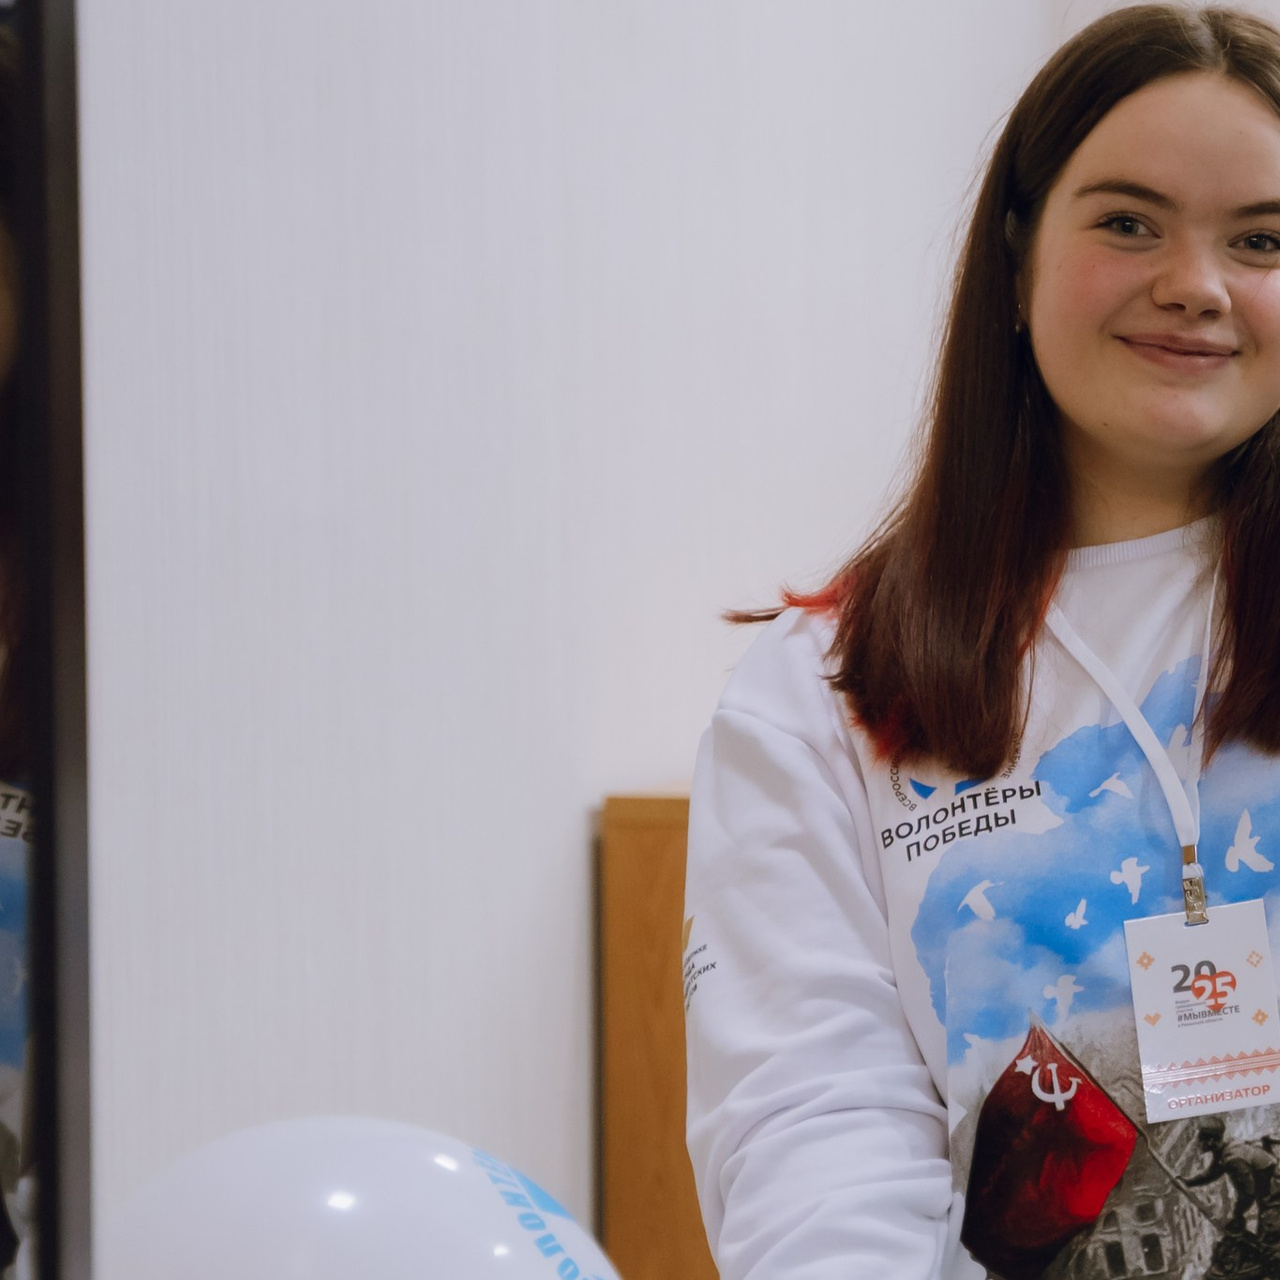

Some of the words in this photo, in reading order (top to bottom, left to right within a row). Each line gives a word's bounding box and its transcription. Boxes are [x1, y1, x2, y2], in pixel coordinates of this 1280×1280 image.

[880, 780, 1042, 850] ВОЛОНТЁРЫ
[905, 809, 1017, 862] ПОБЕДЫ
[1177, 1005, 1241, 1023] #МЫВМЕСТЕ
[1167, 1084, 1271, 1111] ОРГАНИЗАТОР
